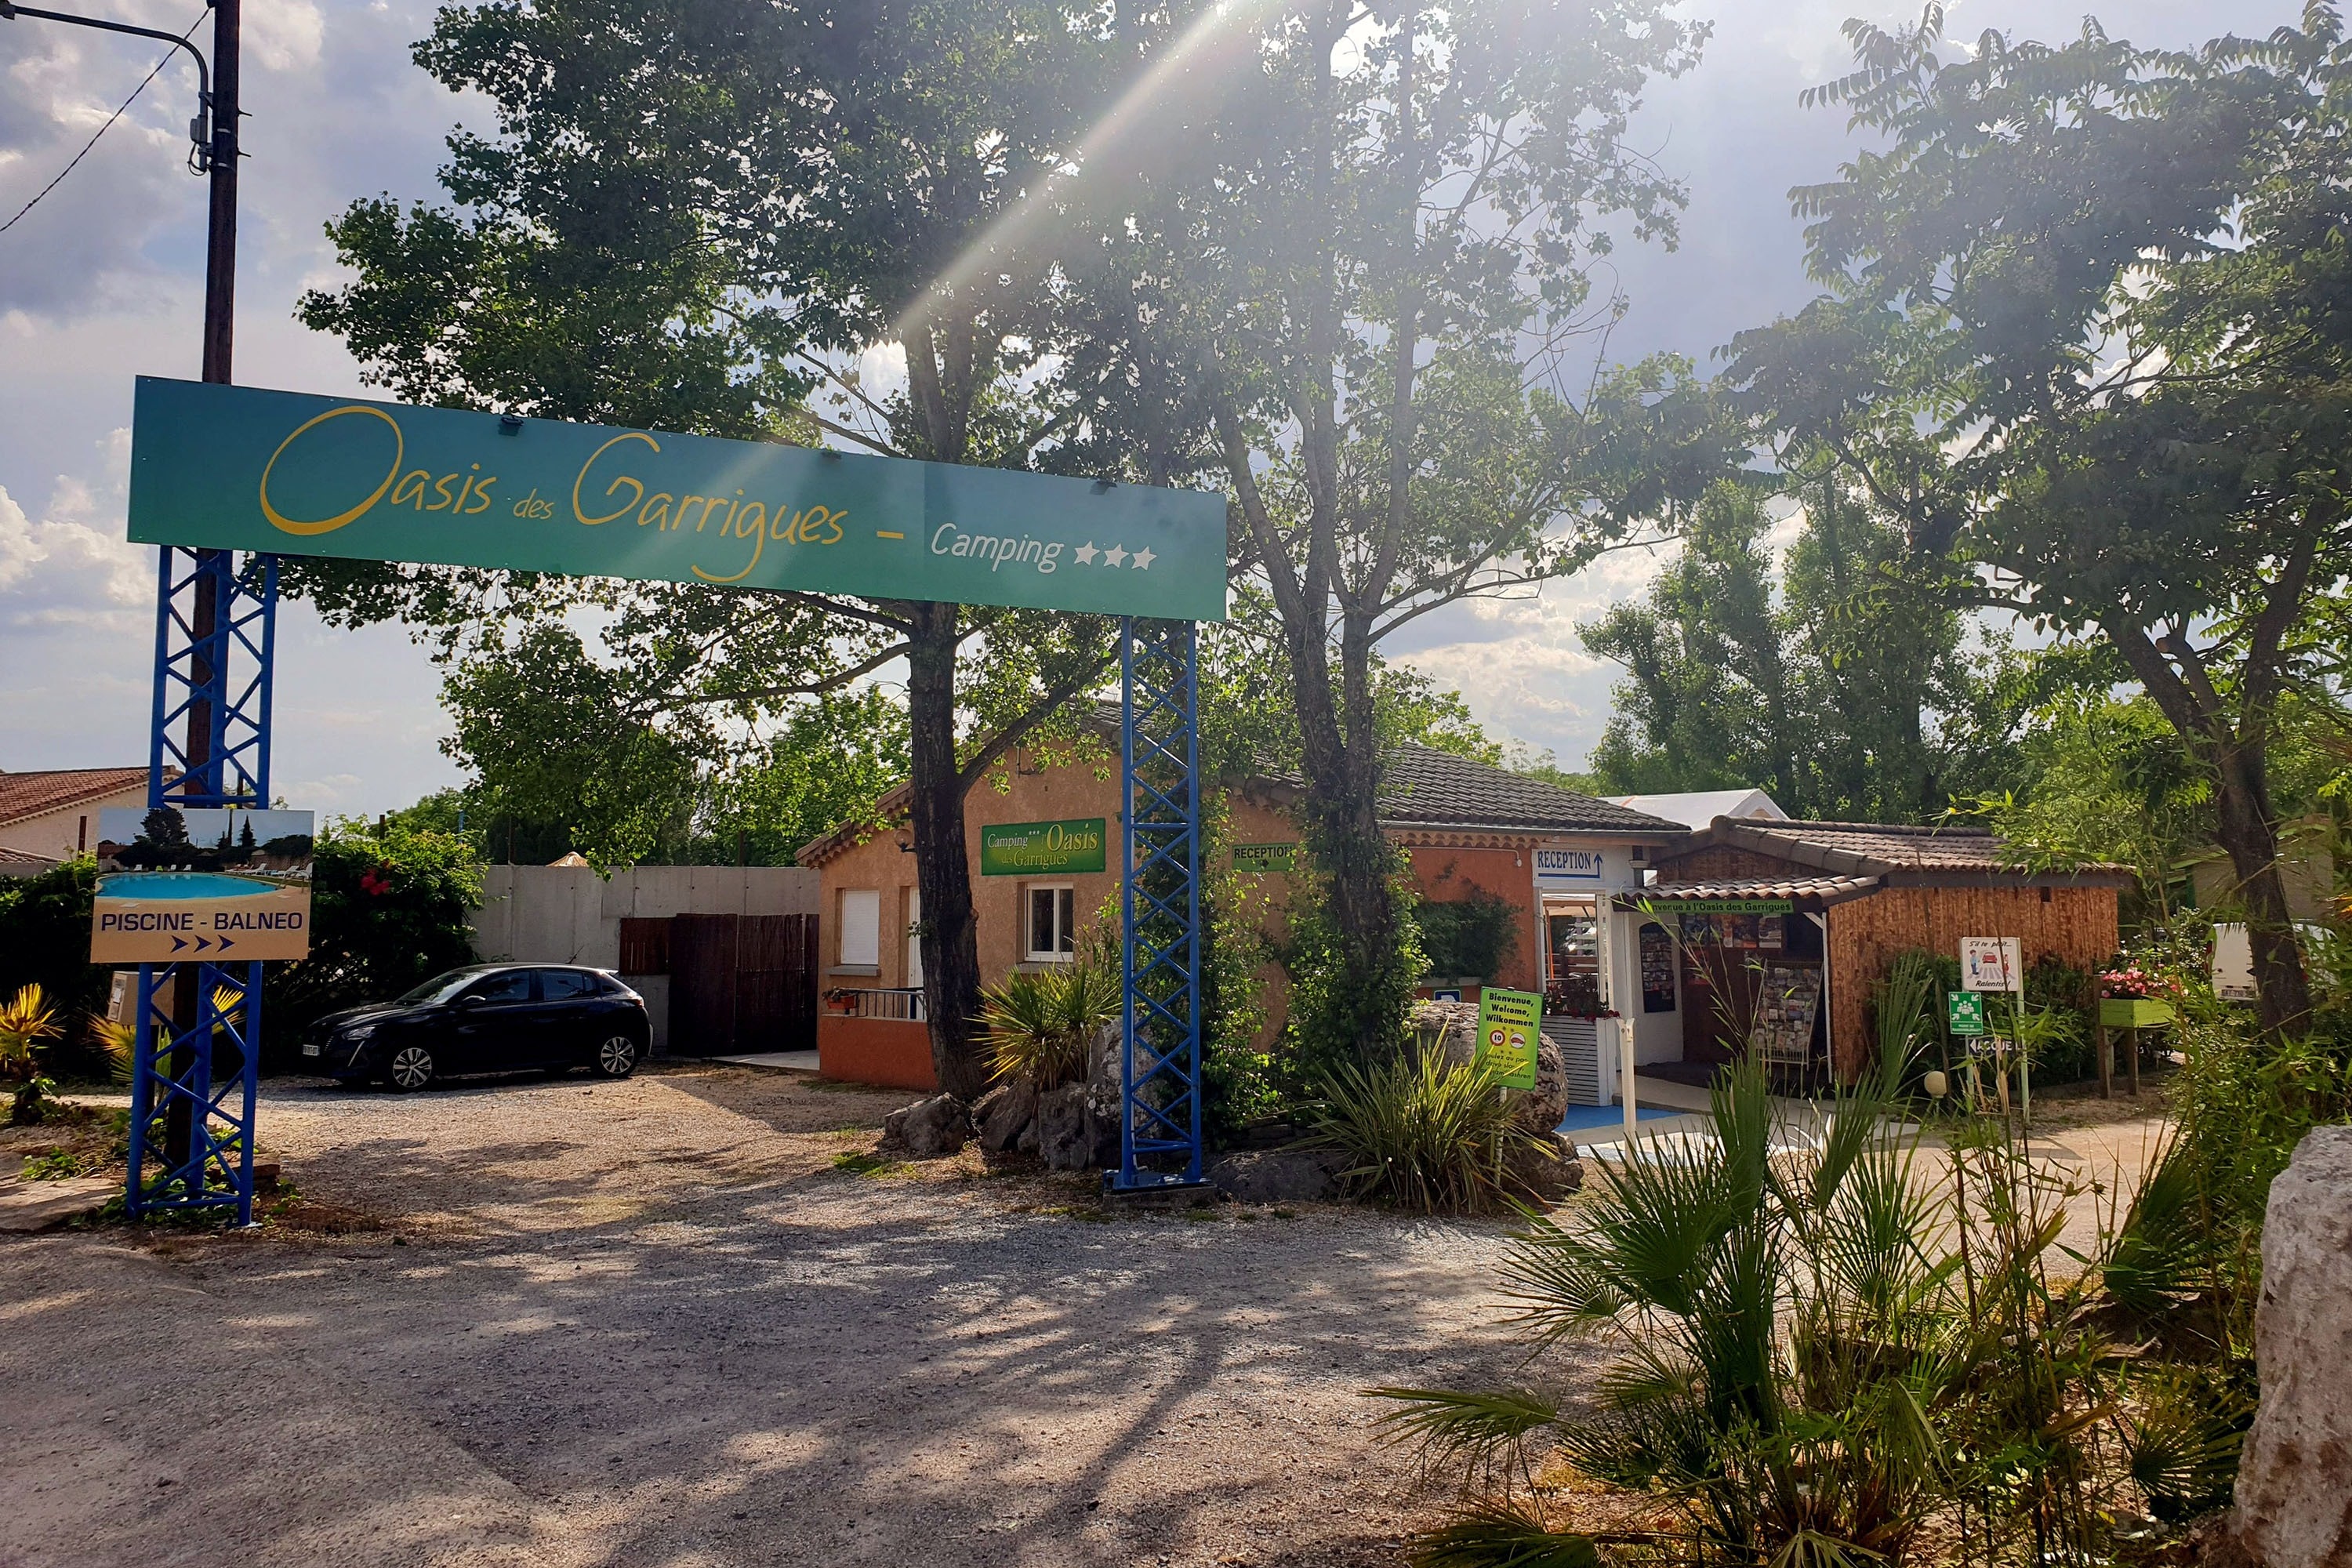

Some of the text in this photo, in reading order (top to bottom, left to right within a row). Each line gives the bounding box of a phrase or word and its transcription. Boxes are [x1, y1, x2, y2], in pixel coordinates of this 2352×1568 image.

[260, 405, 497, 535] Oasis
[513, 488, 555, 520] des
[572, 432, 849, 582] Garrigues
[931, 521, 1065, 574] Camping
[987, 833, 1029, 850] Camping
[1014, 850, 1069, 869] Garrigues
[1234, 847, 1293, 859] RECEPTION
[1537, 851, 1591, 869] RECEPTION
[1686, 902, 1691, 911] à
[1693, 902, 1723, 911] l'Oasis
[1726, 902, 1743, 911] des
[1744, 902, 1791, 913] Garrigues
[101, 913, 194, 931] PISCINE
[214, 912, 303, 930] BALNEO
[1489, 993, 1534, 1007] Bienvenue,
[1491, 1004, 1530, 1017] Welcome,
[1486, 1014, 1534, 1027] Wilkommen
